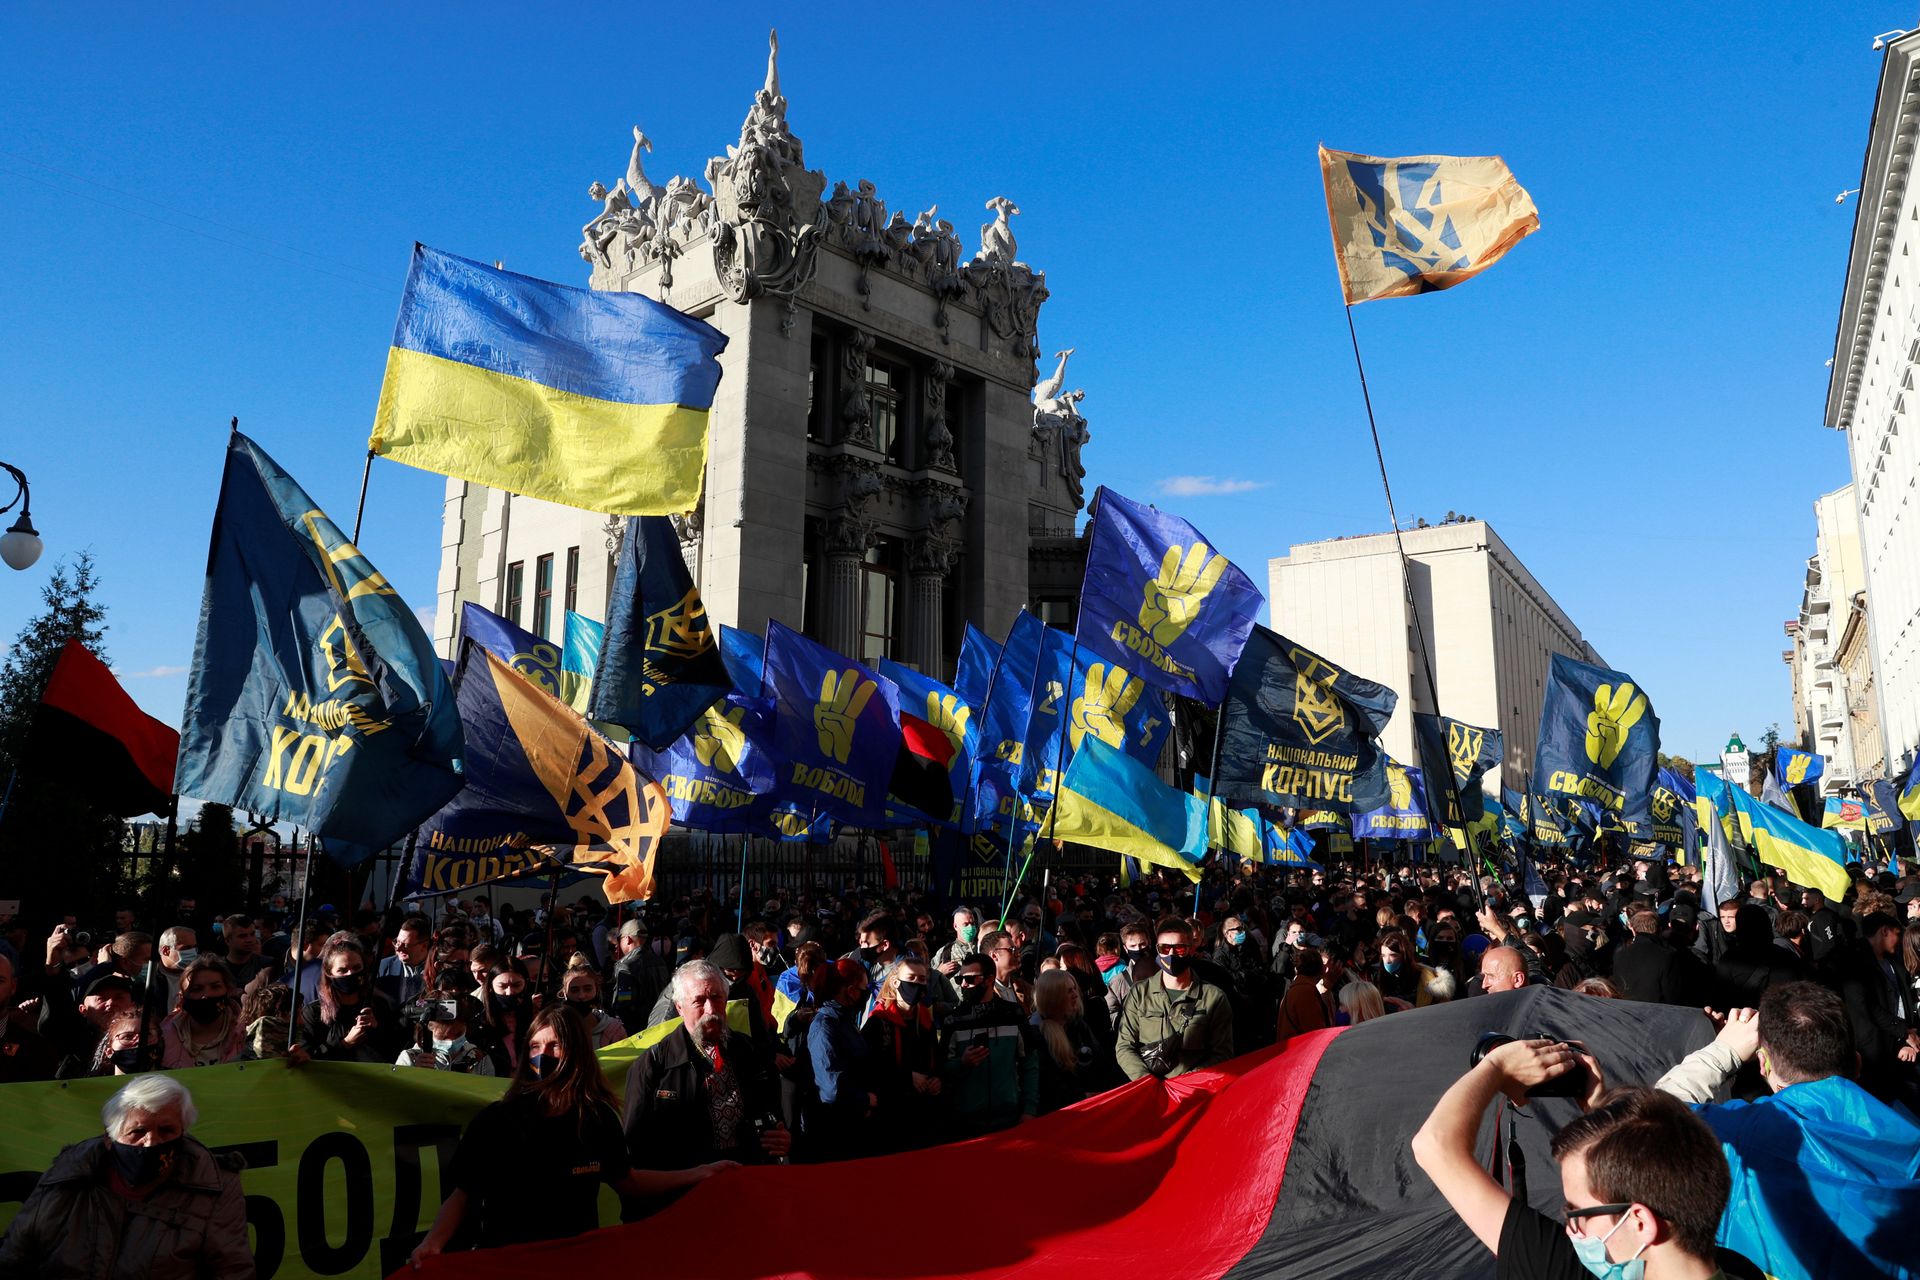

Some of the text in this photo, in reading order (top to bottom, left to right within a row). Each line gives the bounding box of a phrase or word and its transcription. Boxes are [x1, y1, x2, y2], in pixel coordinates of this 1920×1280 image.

[1267, 743, 1358, 772] НАЦІОНАЛЬНИЙ
[790, 760, 865, 808] ВОБОДА
[1261, 762, 1353, 803] КОРПУС
[1371, 815, 1427, 829] СВОБОДА
